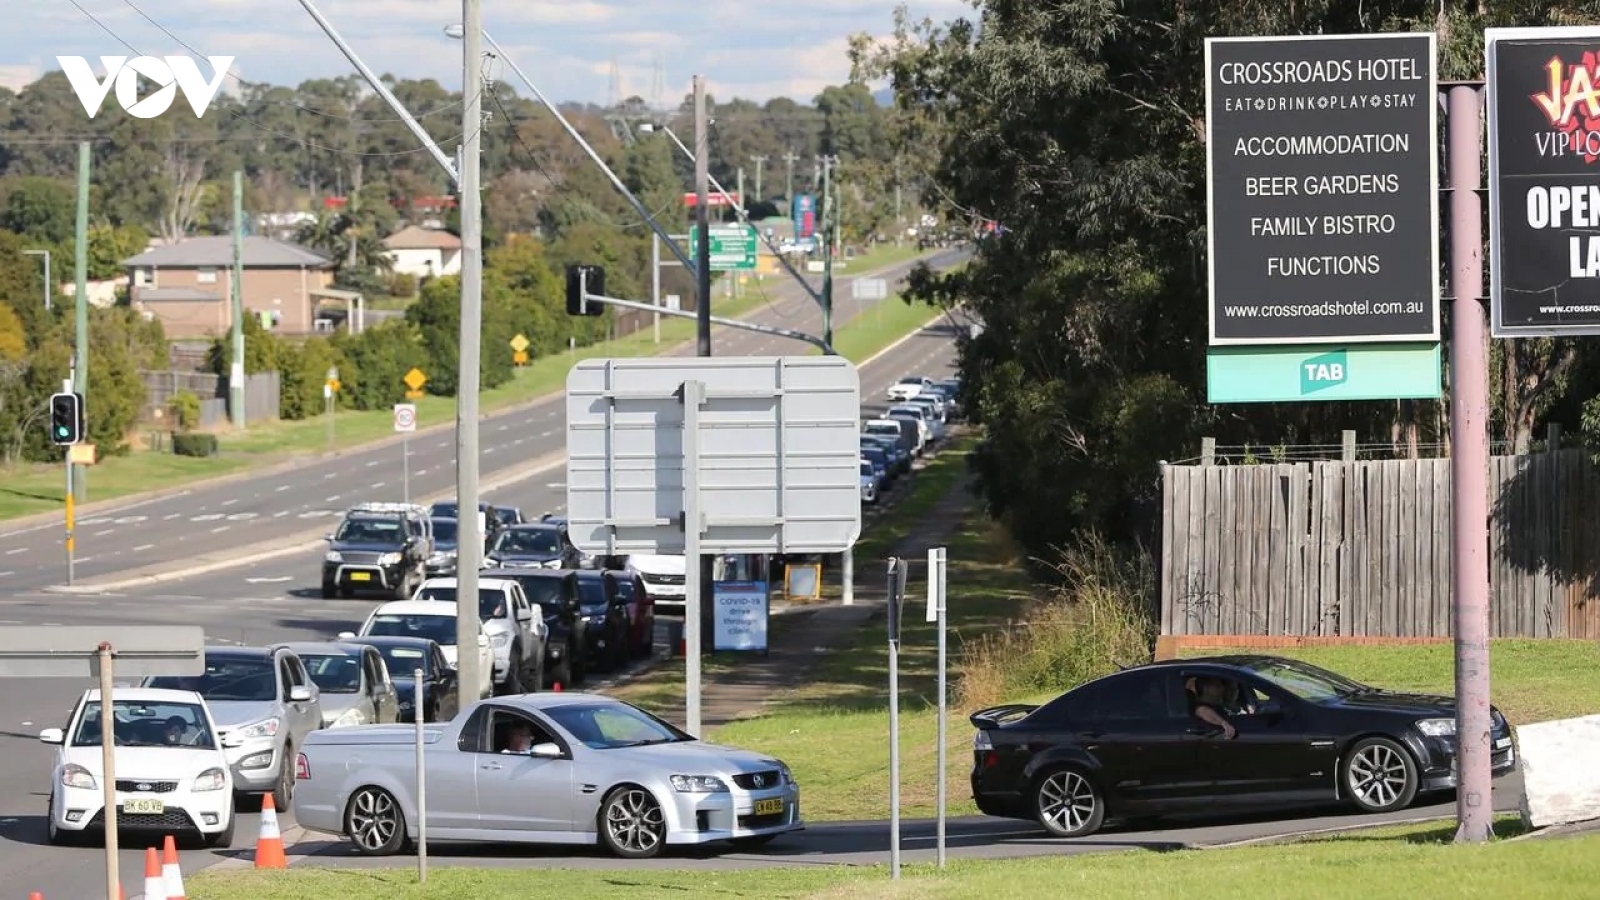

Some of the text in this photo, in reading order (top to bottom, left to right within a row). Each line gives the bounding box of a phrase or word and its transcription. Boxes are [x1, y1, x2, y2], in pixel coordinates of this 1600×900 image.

[1219, 58, 1422, 84] CROSSROADS HOTEL
[1225, 93, 1416, 111] EAT DRINK PLAY STAY
[1234, 133, 1409, 156] ACCOMMODATION
[1535, 131, 1570, 156] VIP
[1245, 174, 1399, 196] BEER GARDENS
[1251, 214, 1395, 236] FAMILY BISTRO
[1267, 254, 1380, 276] FUNCTIONS
[1224, 300, 1424, 317] www.crossroadshotel.com.au
[1305, 363, 1343, 381] TAB
